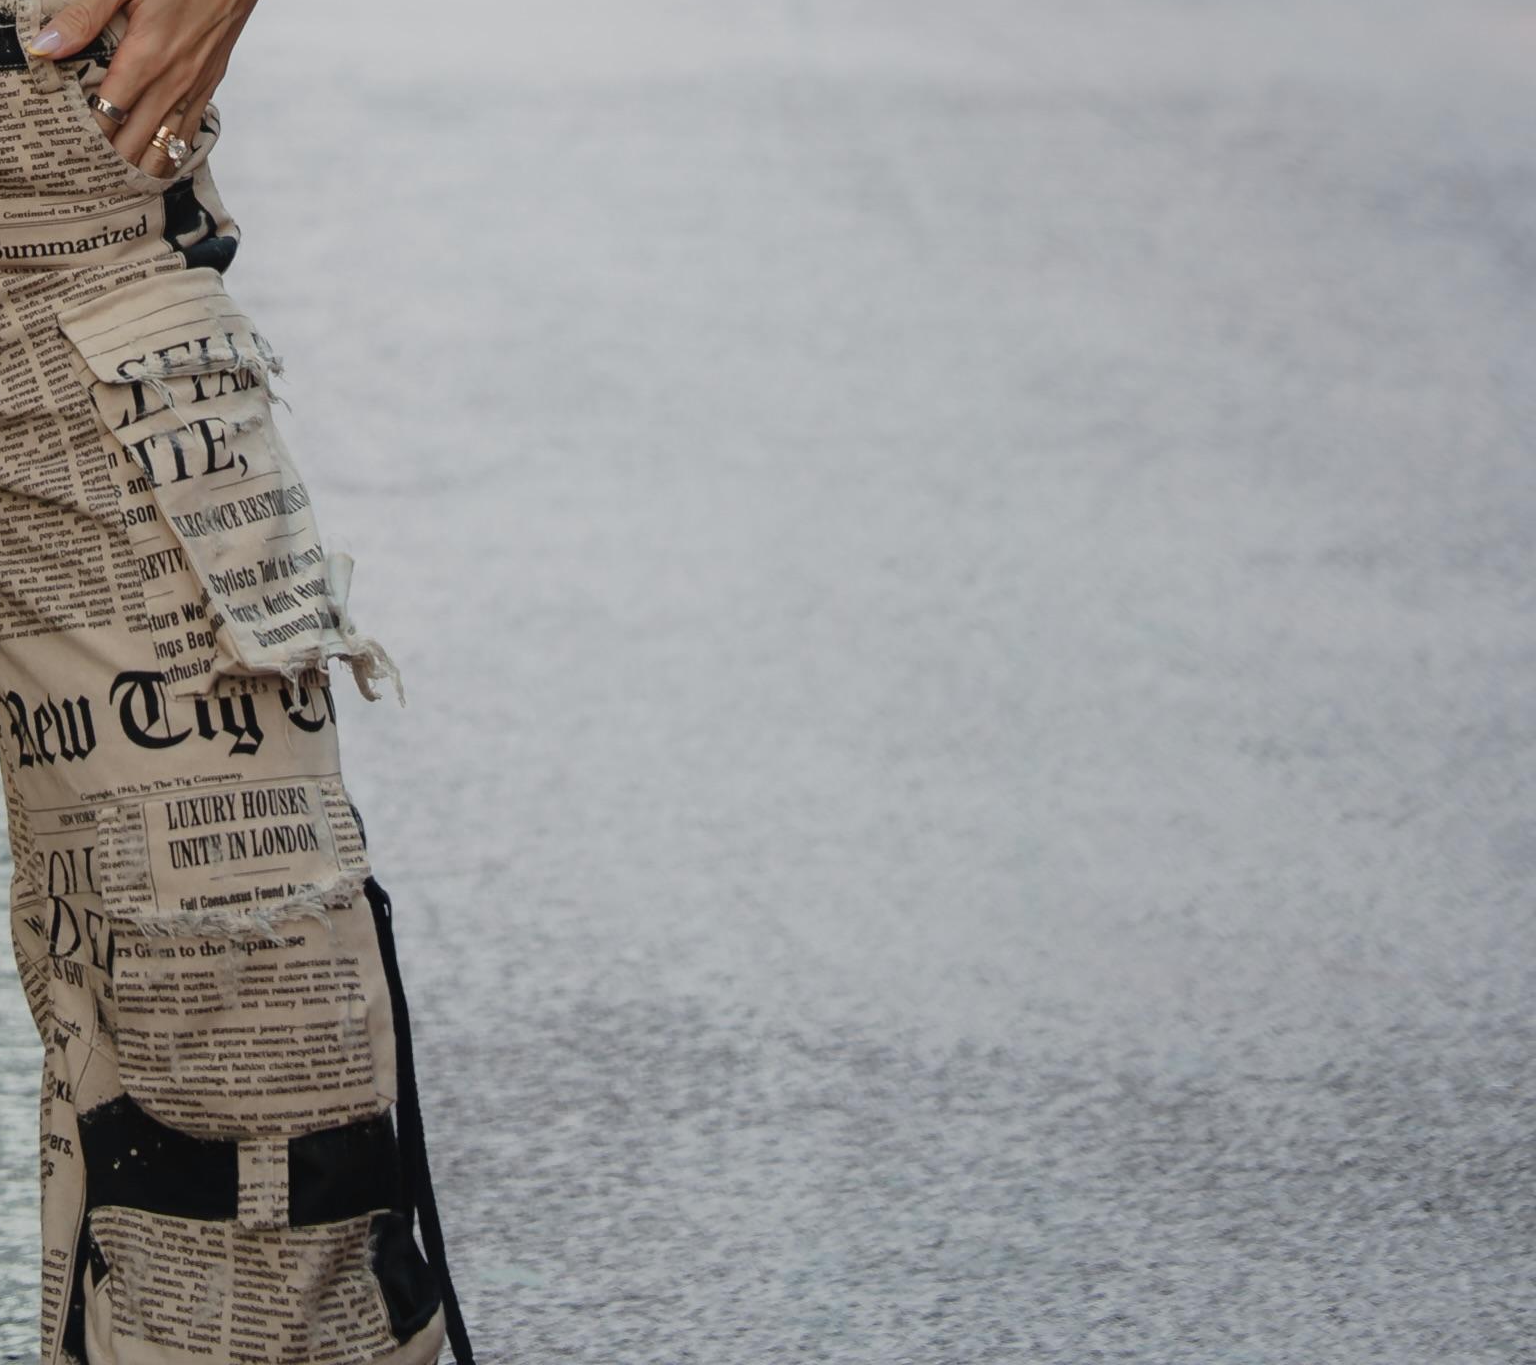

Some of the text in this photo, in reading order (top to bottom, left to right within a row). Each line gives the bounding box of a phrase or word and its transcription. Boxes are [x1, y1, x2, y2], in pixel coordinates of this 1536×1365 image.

[23, 97, 49, 108] shops
[19, 107, 54, 118] Limited
[34, 117, 60, 128] spark
[50, 136, 82, 149] luxury
[3, 207, 55, 220] Continued
[73, 202, 96, 215] Page
[208, 565, 257, 596] Stylists
[154, 779, 172, 791] The
[174, 776, 193, 790] Tig
[194, 771, 244, 786] Company.
[164, 785, 312, 832] LUXURY HOUSES
[225, 830, 247, 861] IN
[251, 821, 320, 858] LONDON
[179, 897, 198, 912] Full
[255, 885, 284, 901] Found
[179, 945, 196, 958] to
[199, 941, 226, 957] the
